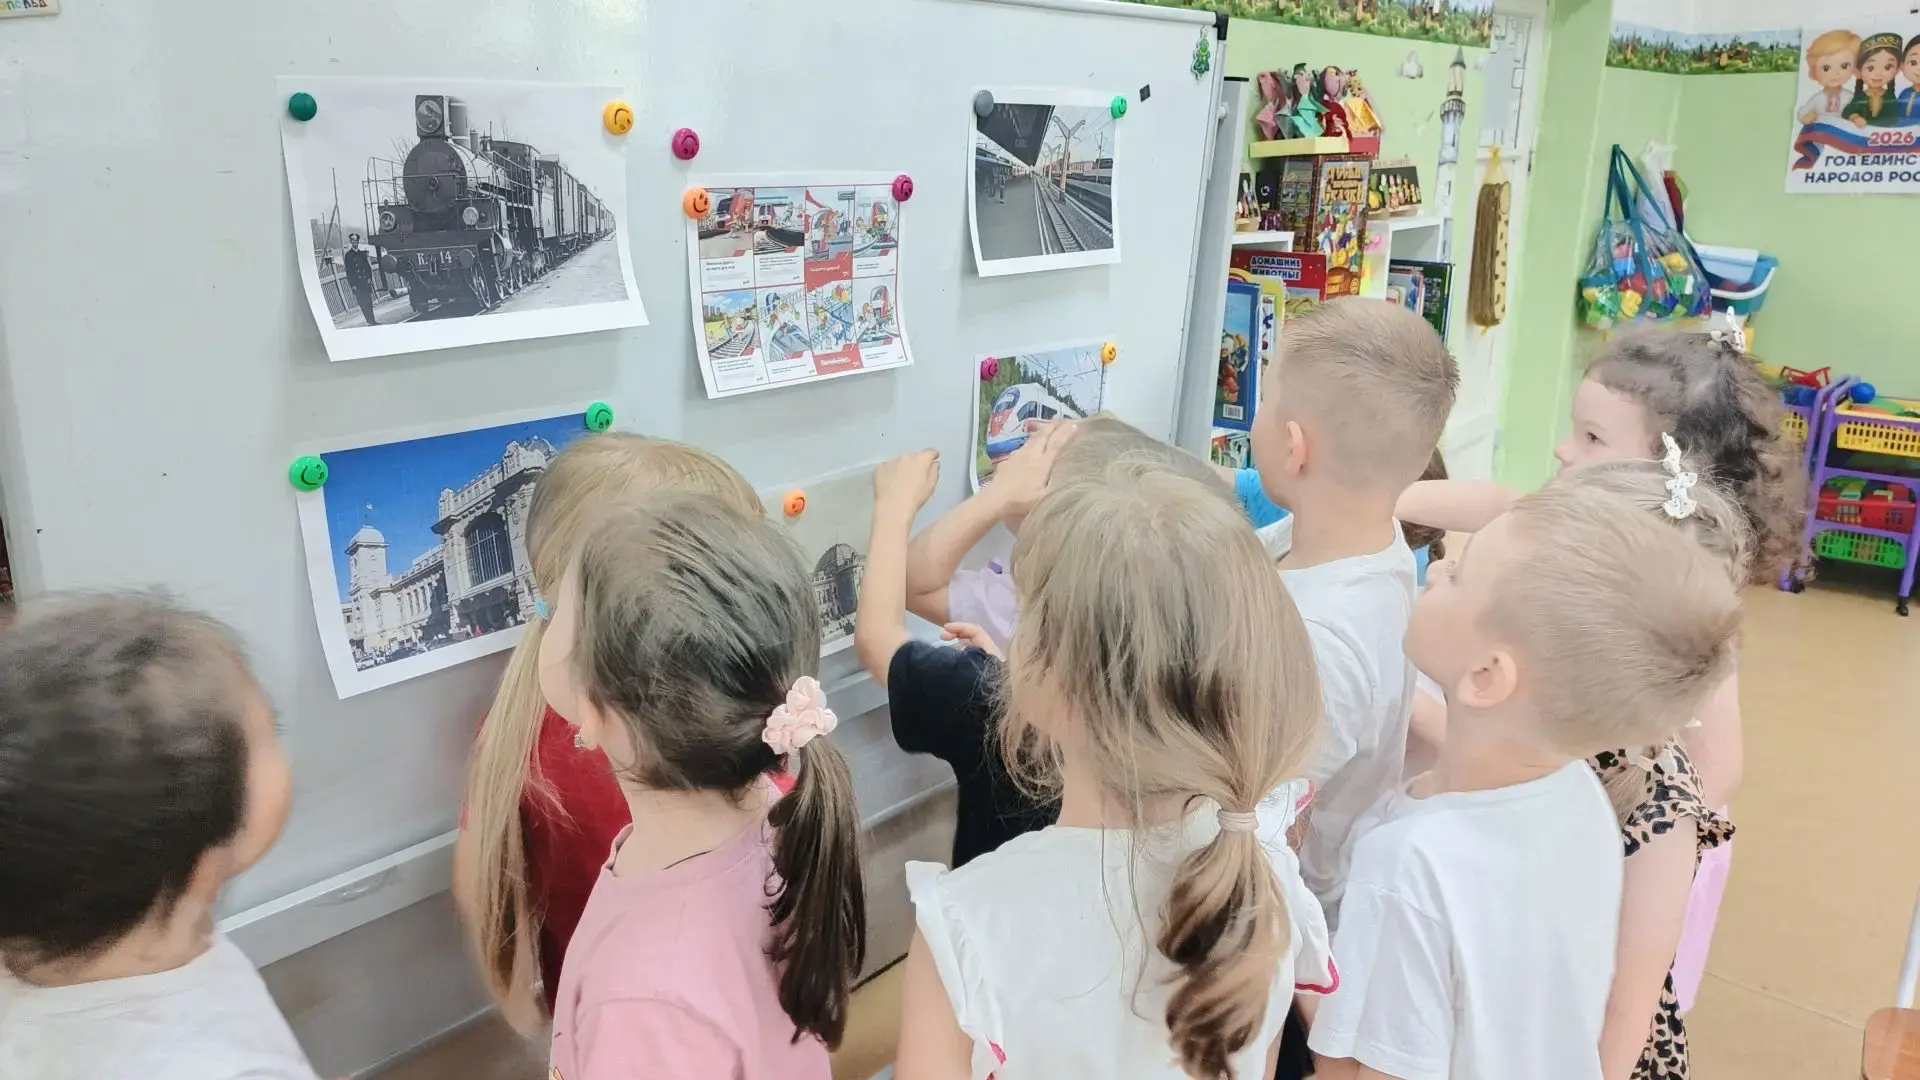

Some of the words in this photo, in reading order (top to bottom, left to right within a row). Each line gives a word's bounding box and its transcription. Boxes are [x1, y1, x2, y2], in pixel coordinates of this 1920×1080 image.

[1869, 131, 1914, 145] 2026
[1824, 155, 1857, 166] ГОД
[1860, 154, 1920, 166] ЕДИНС
[1804, 171, 1884, 183] НАРОДОВ
[1251, 256, 1301, 267] ДОМАШНИЕ
[1251, 268, 1301, 279] ЖИВОТНЫЕ
